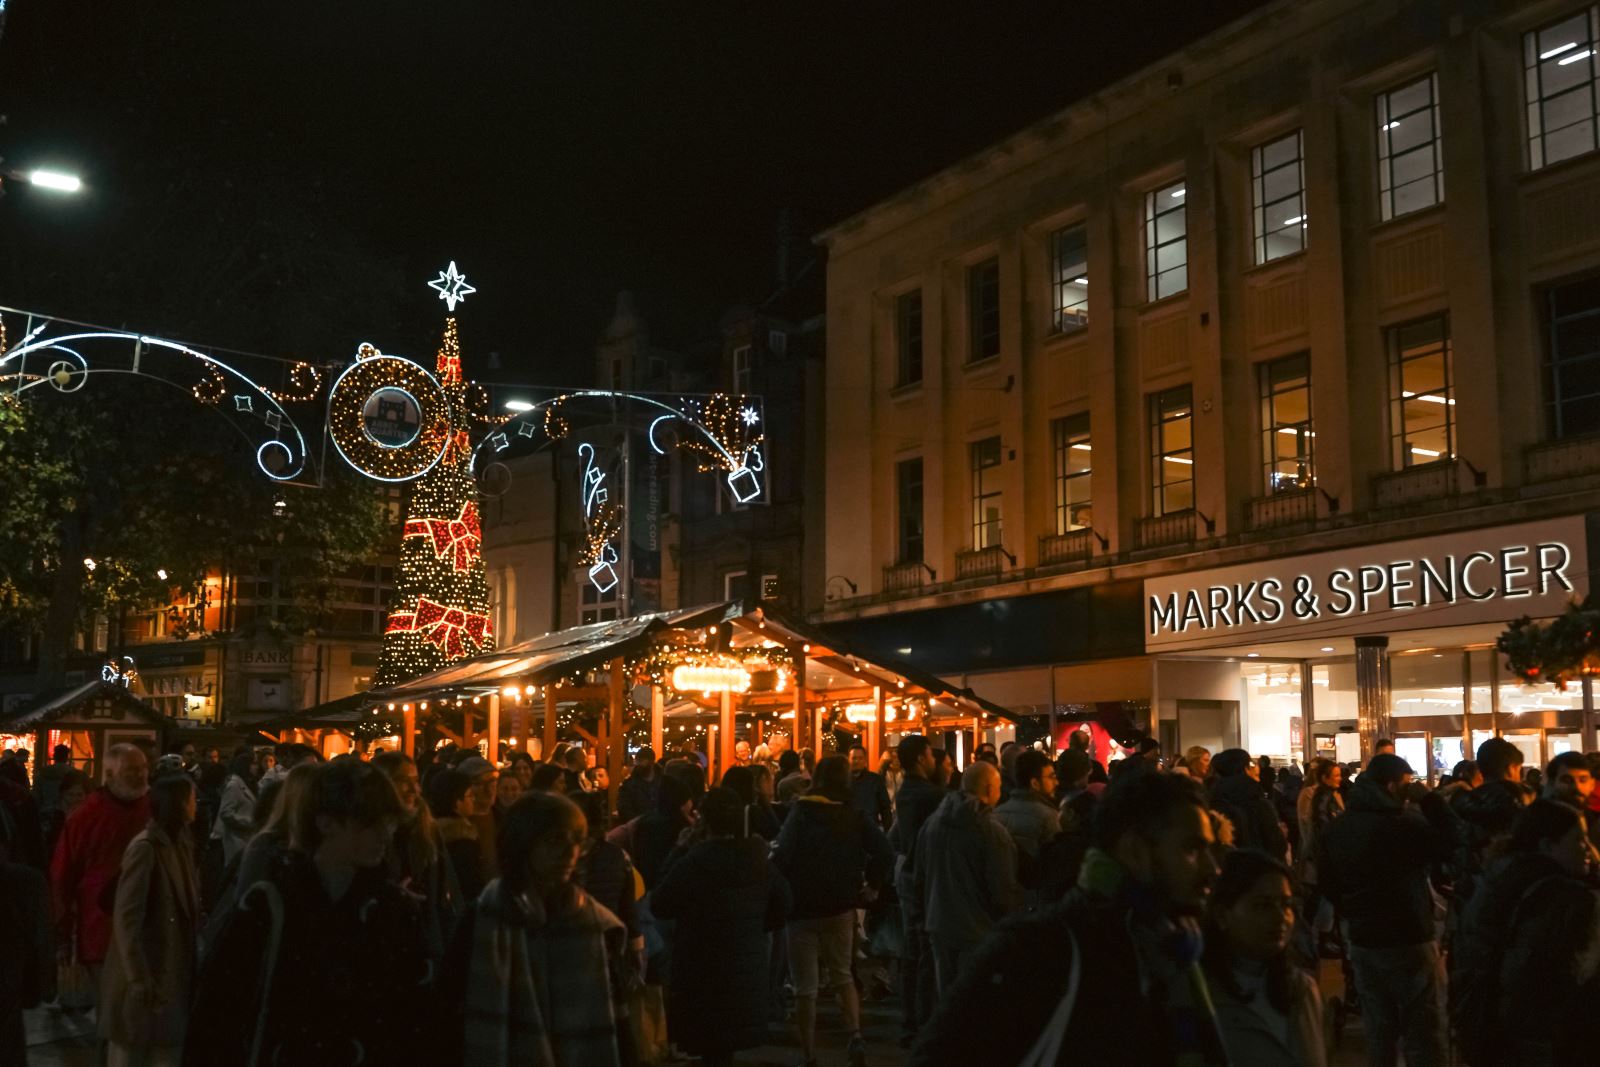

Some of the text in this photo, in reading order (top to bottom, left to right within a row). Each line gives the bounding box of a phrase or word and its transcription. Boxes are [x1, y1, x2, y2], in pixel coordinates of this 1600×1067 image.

[1150, 542, 1574, 636] MARKS & SPENCER
[244, 651, 288, 663] BANK
